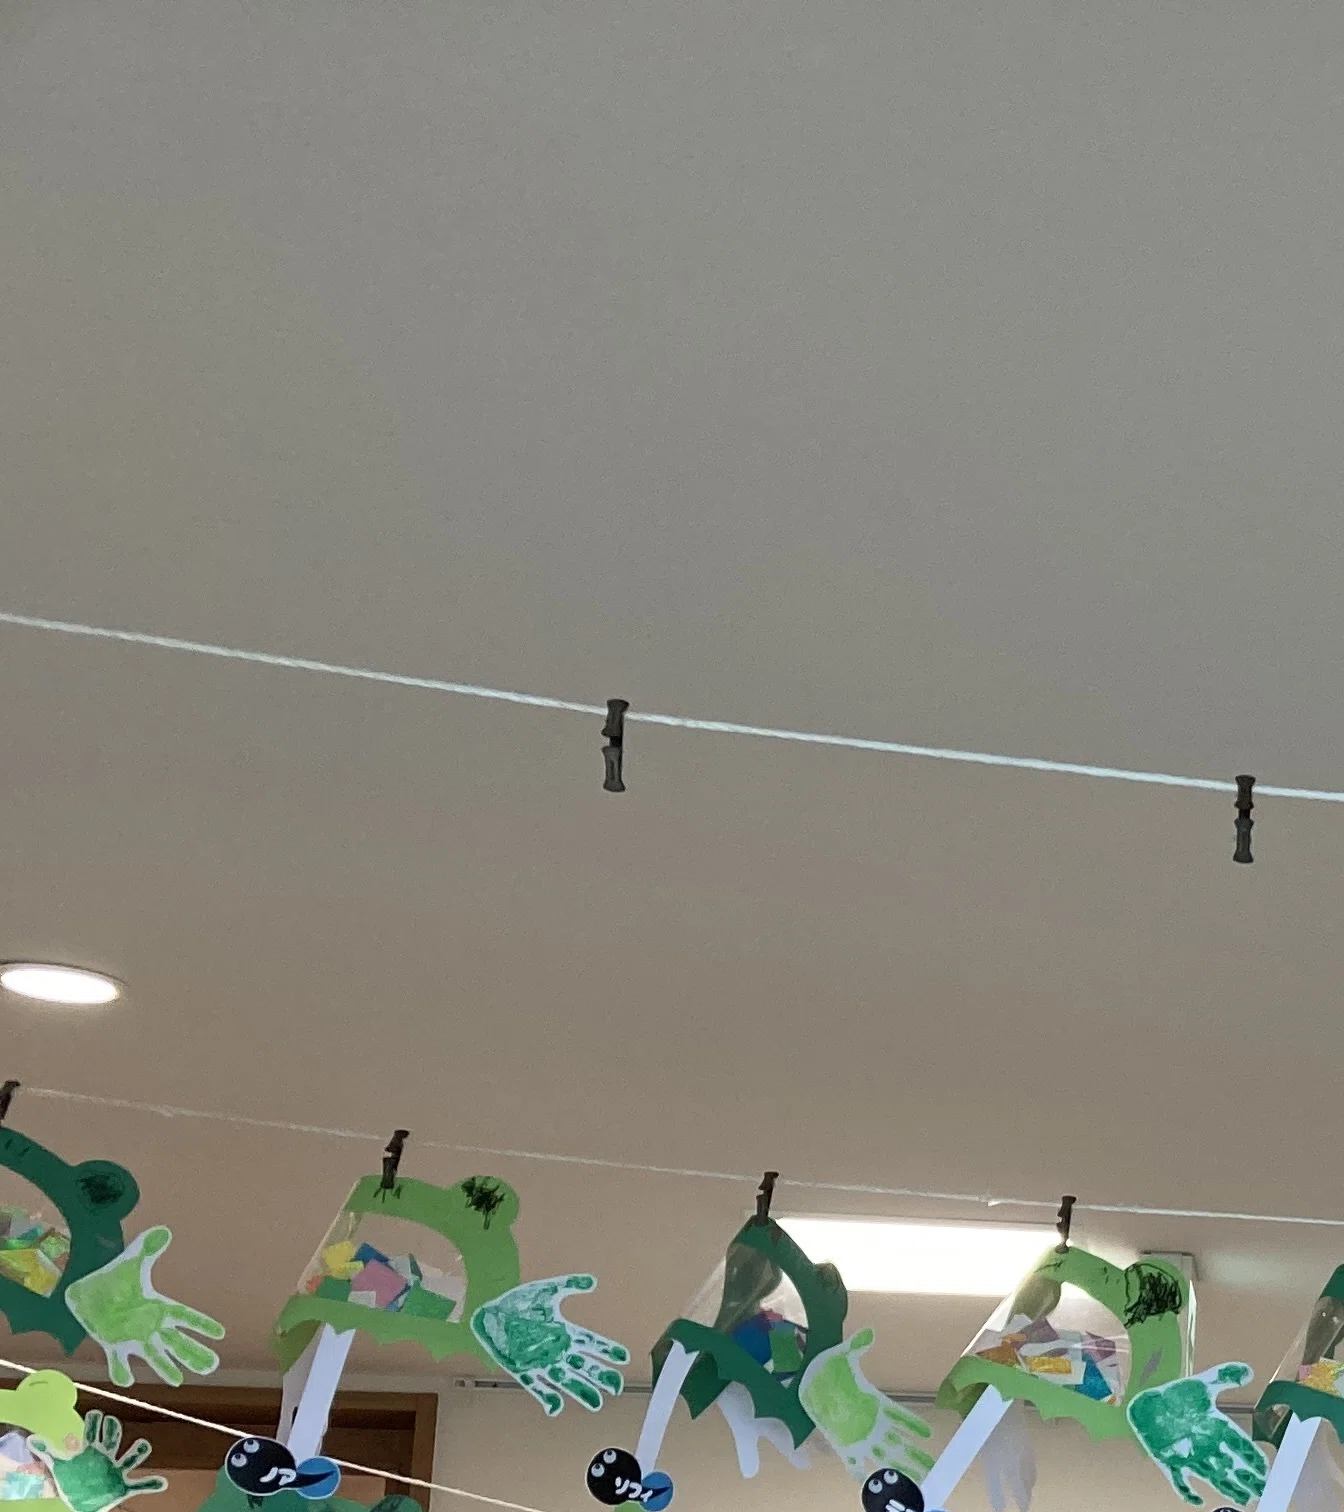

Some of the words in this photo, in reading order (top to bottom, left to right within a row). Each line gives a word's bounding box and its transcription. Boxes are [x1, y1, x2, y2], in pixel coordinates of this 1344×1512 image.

[258, 1466, 297, 1486] ノア
[614, 1476, 654, 1503] リフィ
